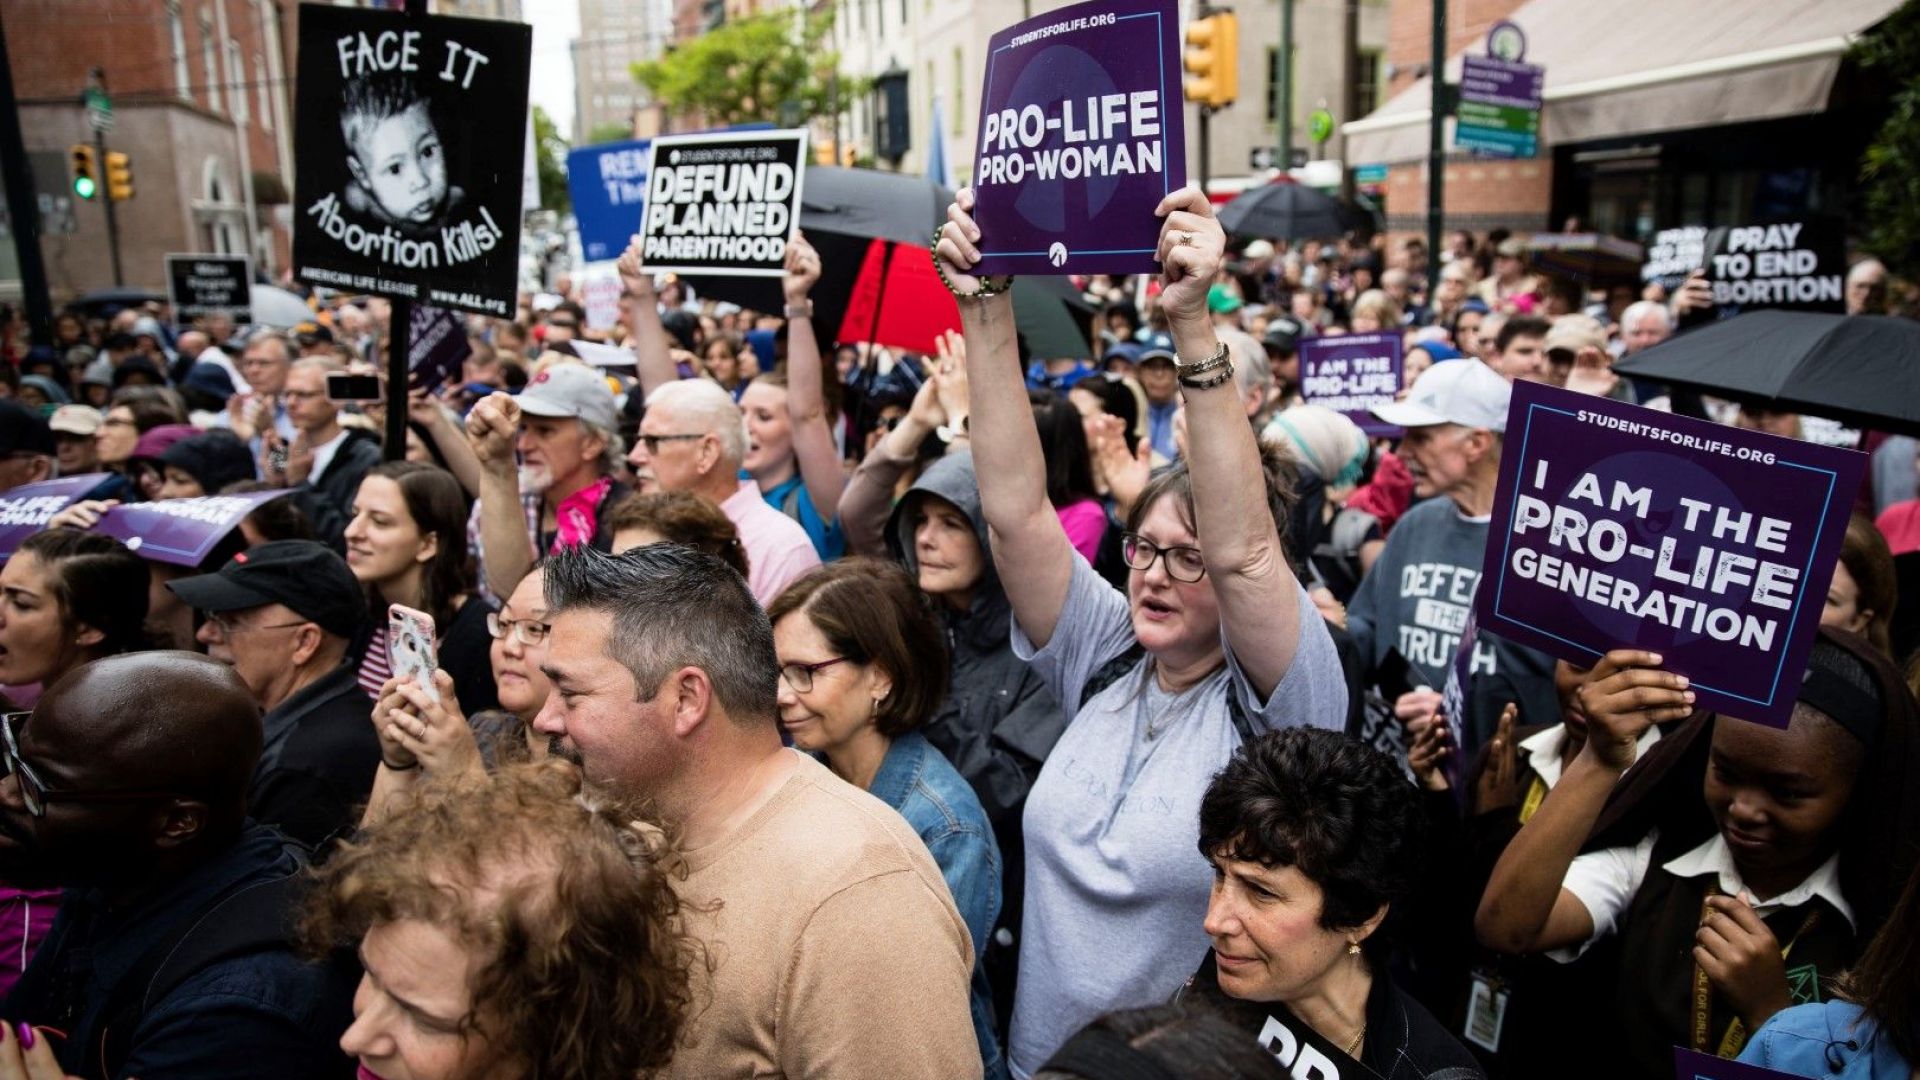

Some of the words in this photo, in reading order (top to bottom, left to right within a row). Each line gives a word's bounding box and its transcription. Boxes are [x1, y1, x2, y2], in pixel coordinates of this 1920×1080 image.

[1010, 13, 1116, 48] STUDENTSFORLIFE.ORG
[337, 31, 421, 78] FACE
[439, 40, 489, 89] IT
[982, 90, 1160, 153] PRO-LIFE
[652, 162, 794, 204] DEFUND
[978, 140, 1162, 186] PRO-WOMAN
[308, 192, 438, 268] Abortion
[442, 205, 502, 266] Kills!
[647, 202, 789, 236] PLANNED
[1728, 223, 1802, 252] PRAY
[644, 236, 785, 261] PARENTHOOD
[1713, 253, 1750, 279] TO
[1755, 249, 1818, 277] END
[301, 267, 352, 286] AMERICAN
[354, 274, 376, 290] LIFE
[377, 278, 419, 298] LEAGUE
[430, 289, 507, 315] www.ALL.org
[1713, 275, 1842, 304] BORTION
[1303, 373, 1397, 397] PRO-LIFE
[1307, 361, 1315, 377] I
[1319, 359, 1348, 376] AM
[1353, 356, 1391, 375] THE
[1576, 409, 1776, 465] STUDENTSFORLIFE.ORG
[1534, 459, 1549, 490] I
[1568, 472, 1653, 519] AM
[1679, 497, 1792, 553] THE
[1513, 494, 1800, 611] PRO-LIFE
[1400, 562, 1477, 604] DEFE
[1511, 547, 1777, 651] GENERATION
[1430, 603, 1464, 632] THE
[1399, 624, 1497, 676] TRUH
[1696, 1011, 1707, 1045] GIRLS
